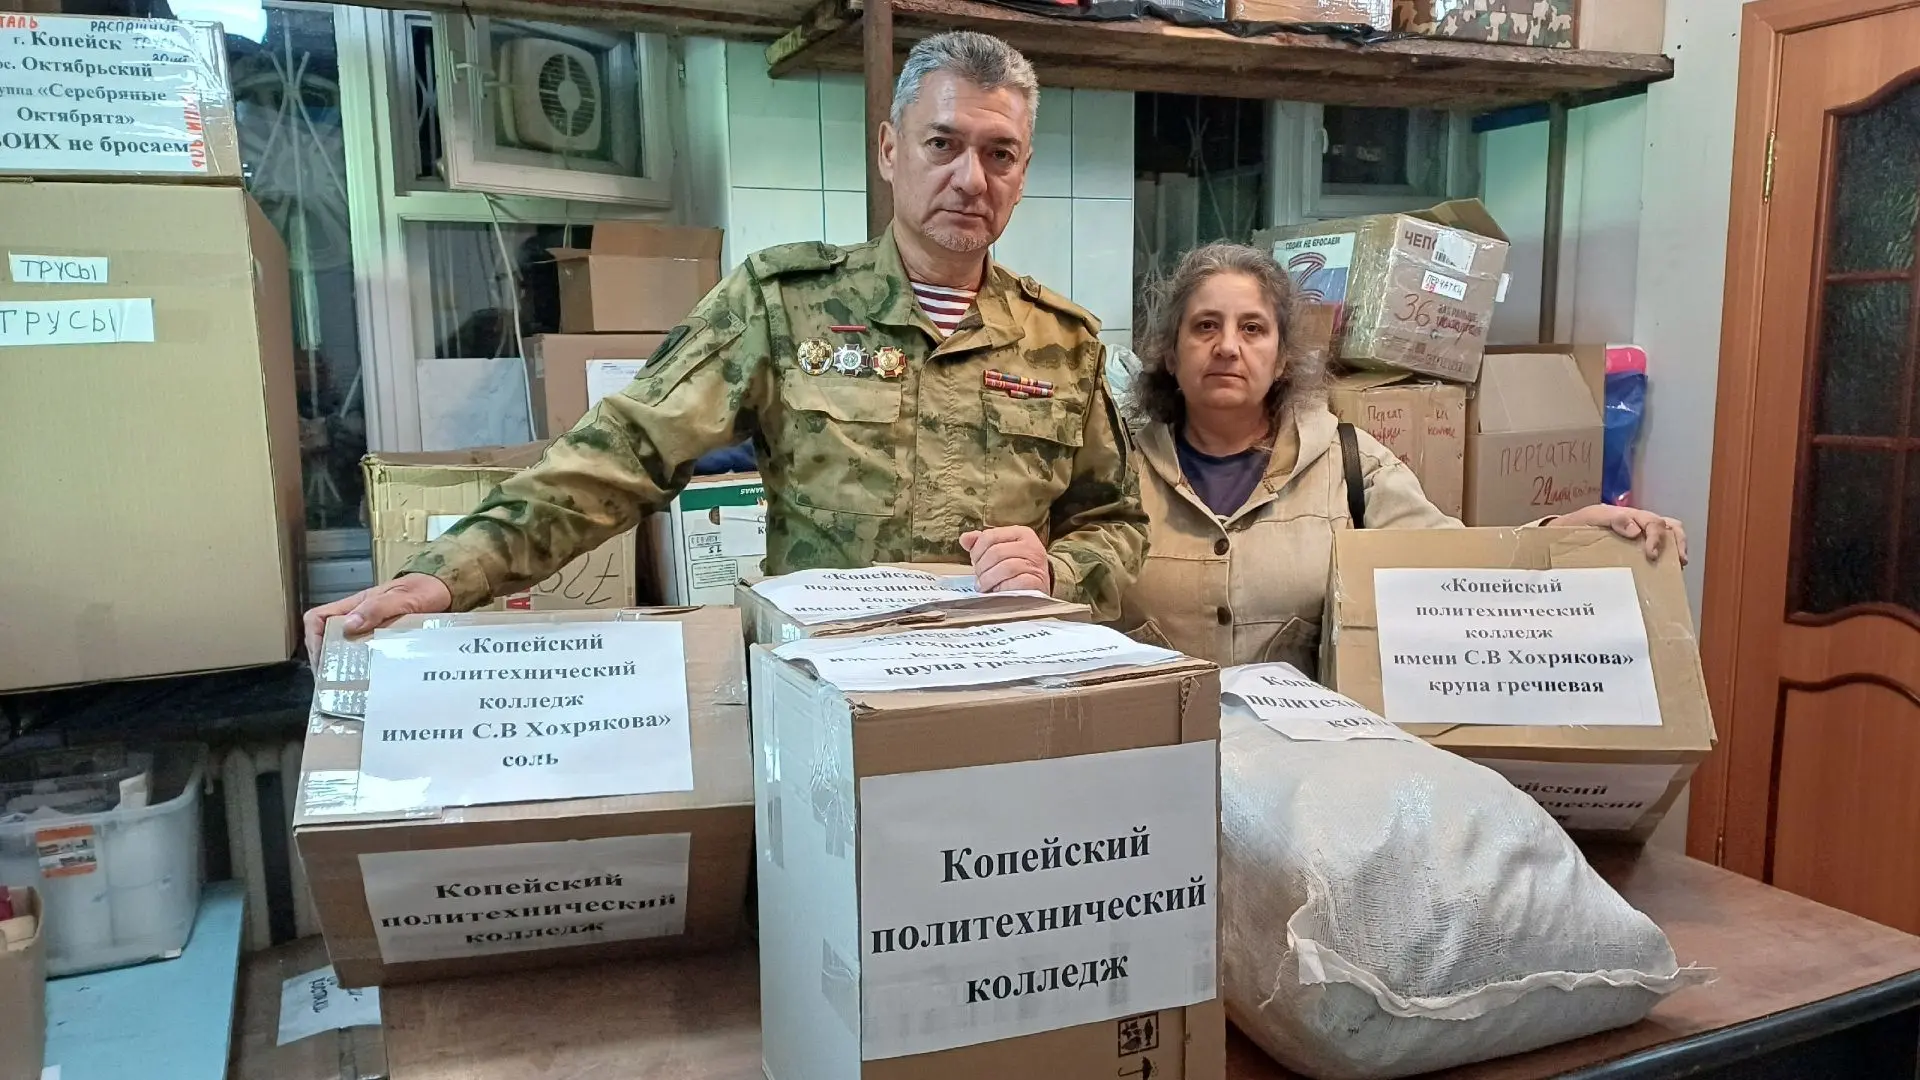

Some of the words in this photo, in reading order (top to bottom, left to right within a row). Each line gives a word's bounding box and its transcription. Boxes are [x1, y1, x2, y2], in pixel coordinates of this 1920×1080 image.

[13, 36, 25, 45] г.
[31, 31, 122, 50] Копейск
[22, 56, 152, 77] Октябрьский
[38, 82, 167, 104] «Серебряные
[17, 106, 136, 126] Октябрята»
[0, 132, 61, 150] ОИХ
[68, 138, 94, 151] не
[100, 136, 189, 157] бросаем
[21, 260, 97, 281] ТРУСЫ
[1394, 293, 1433, 327] 36
[0, 309, 116, 335] ТРУСЫ
[822, 569, 937, 582] «Копейский
[1441, 577, 1562, 595] «Копейский
[1416, 603, 1595, 618] политехнический
[458, 633, 604, 655] «Копейский
[1465, 628, 1554, 640] колледж
[884, 661, 967, 676] крупа
[1394, 654, 1458, 666] имени
[1464, 649, 1501, 665] С.В
[1508, 649, 1635, 668] Хохрякова»
[422, 661, 636, 682] политехнический
[1429, 680, 1490, 696] крупа
[1497, 679, 1605, 693] гречневая
[479, 694, 584, 710] колледж
[382, 728, 463, 742] имени
[472, 721, 518, 740] С.В
[526, 714, 671, 738] Хохрякова»
[502, 752, 559, 768] соль
[941, 825, 1150, 883] Копейский
[435, 873, 623, 899] Копейский
[381, 894, 676, 928] политехнический
[871, 874, 1207, 954] политехнический
[466, 921, 605, 944] колледж
[966, 955, 1129, 1004] колледж
